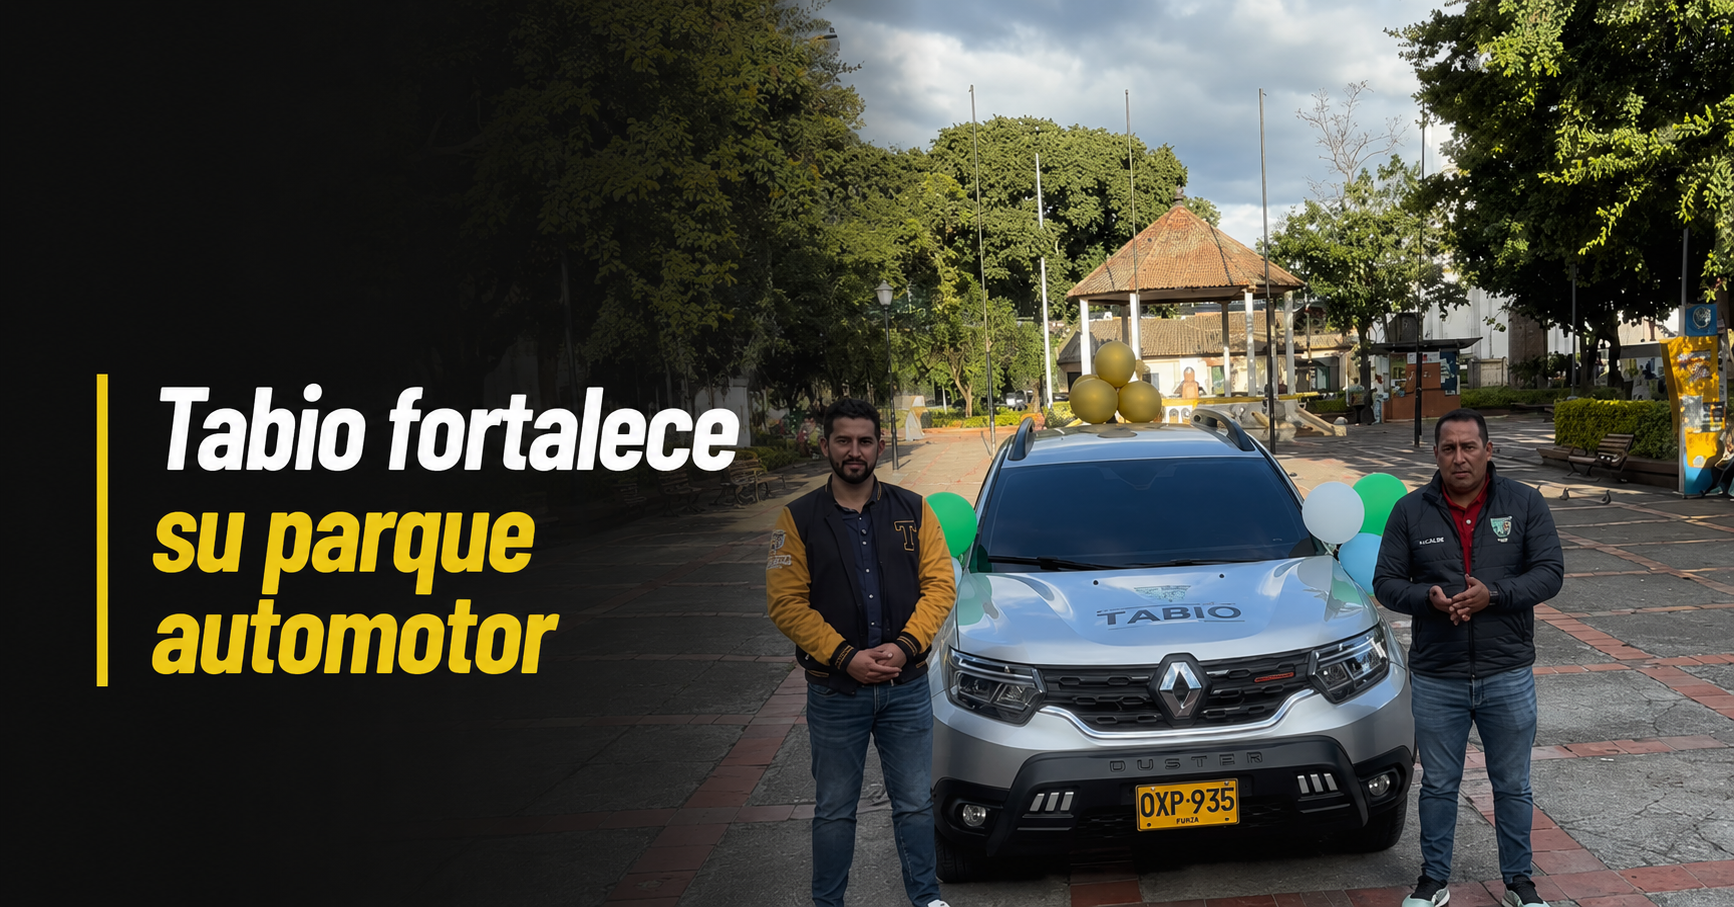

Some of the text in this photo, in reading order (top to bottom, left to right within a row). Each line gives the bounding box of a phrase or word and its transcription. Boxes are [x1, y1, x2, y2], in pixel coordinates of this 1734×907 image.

[894, 520, 917, 551] T
[1097, 606, 1242, 626] TABIO
[1109, 751, 1264, 772] DUSTER
